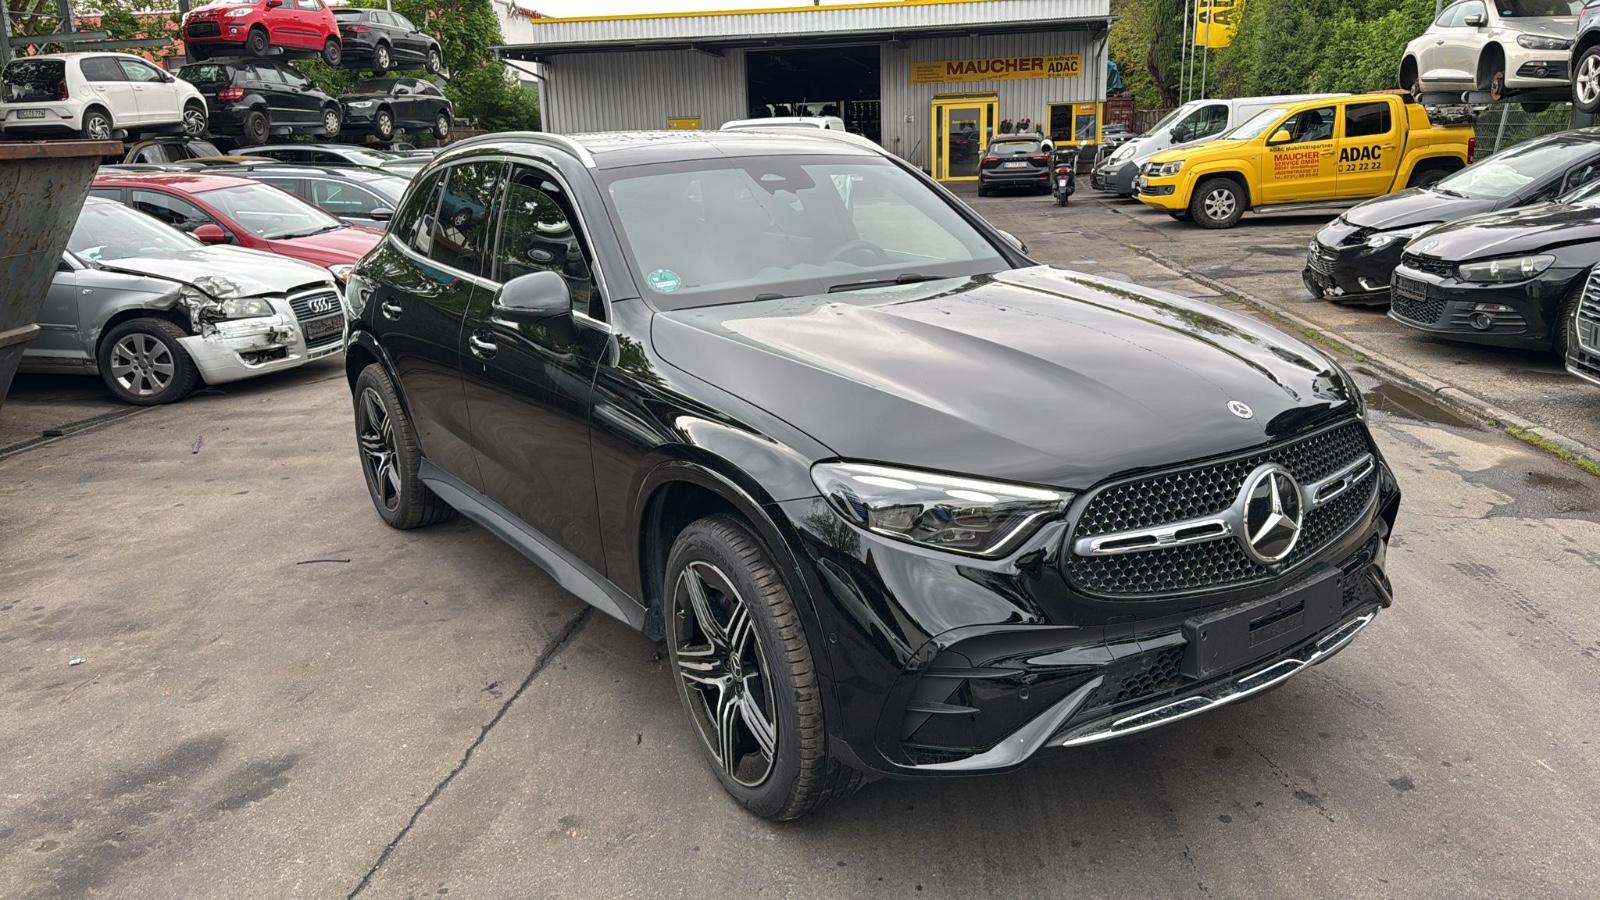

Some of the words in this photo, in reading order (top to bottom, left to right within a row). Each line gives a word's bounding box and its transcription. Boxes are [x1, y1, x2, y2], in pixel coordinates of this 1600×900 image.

[946, 58, 1044, 75] MAUCHER
[1048, 61, 1078, 73] ADAC
[1274, 152, 1320, 162] MAUCHER
[1339, 145, 1382, 163] ADAC
